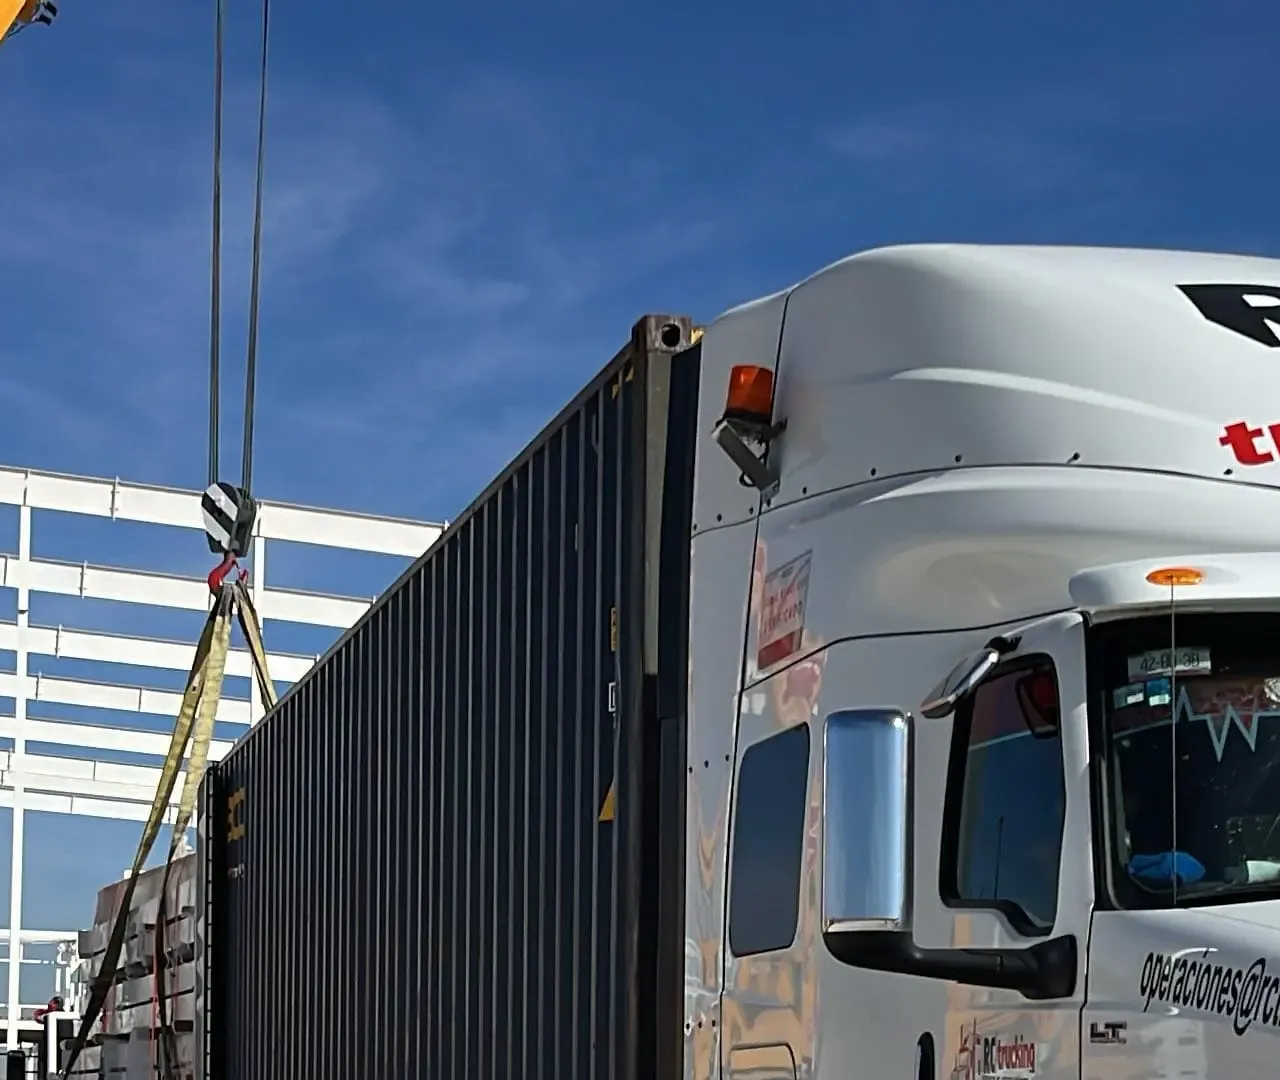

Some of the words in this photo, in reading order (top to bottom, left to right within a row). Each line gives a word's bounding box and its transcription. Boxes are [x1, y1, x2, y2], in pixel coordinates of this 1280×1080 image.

[1090, 1021, 1128, 1042] LT
[983, 1036, 996, 1074] RC
[997, 1034, 1036, 1073] trucking
